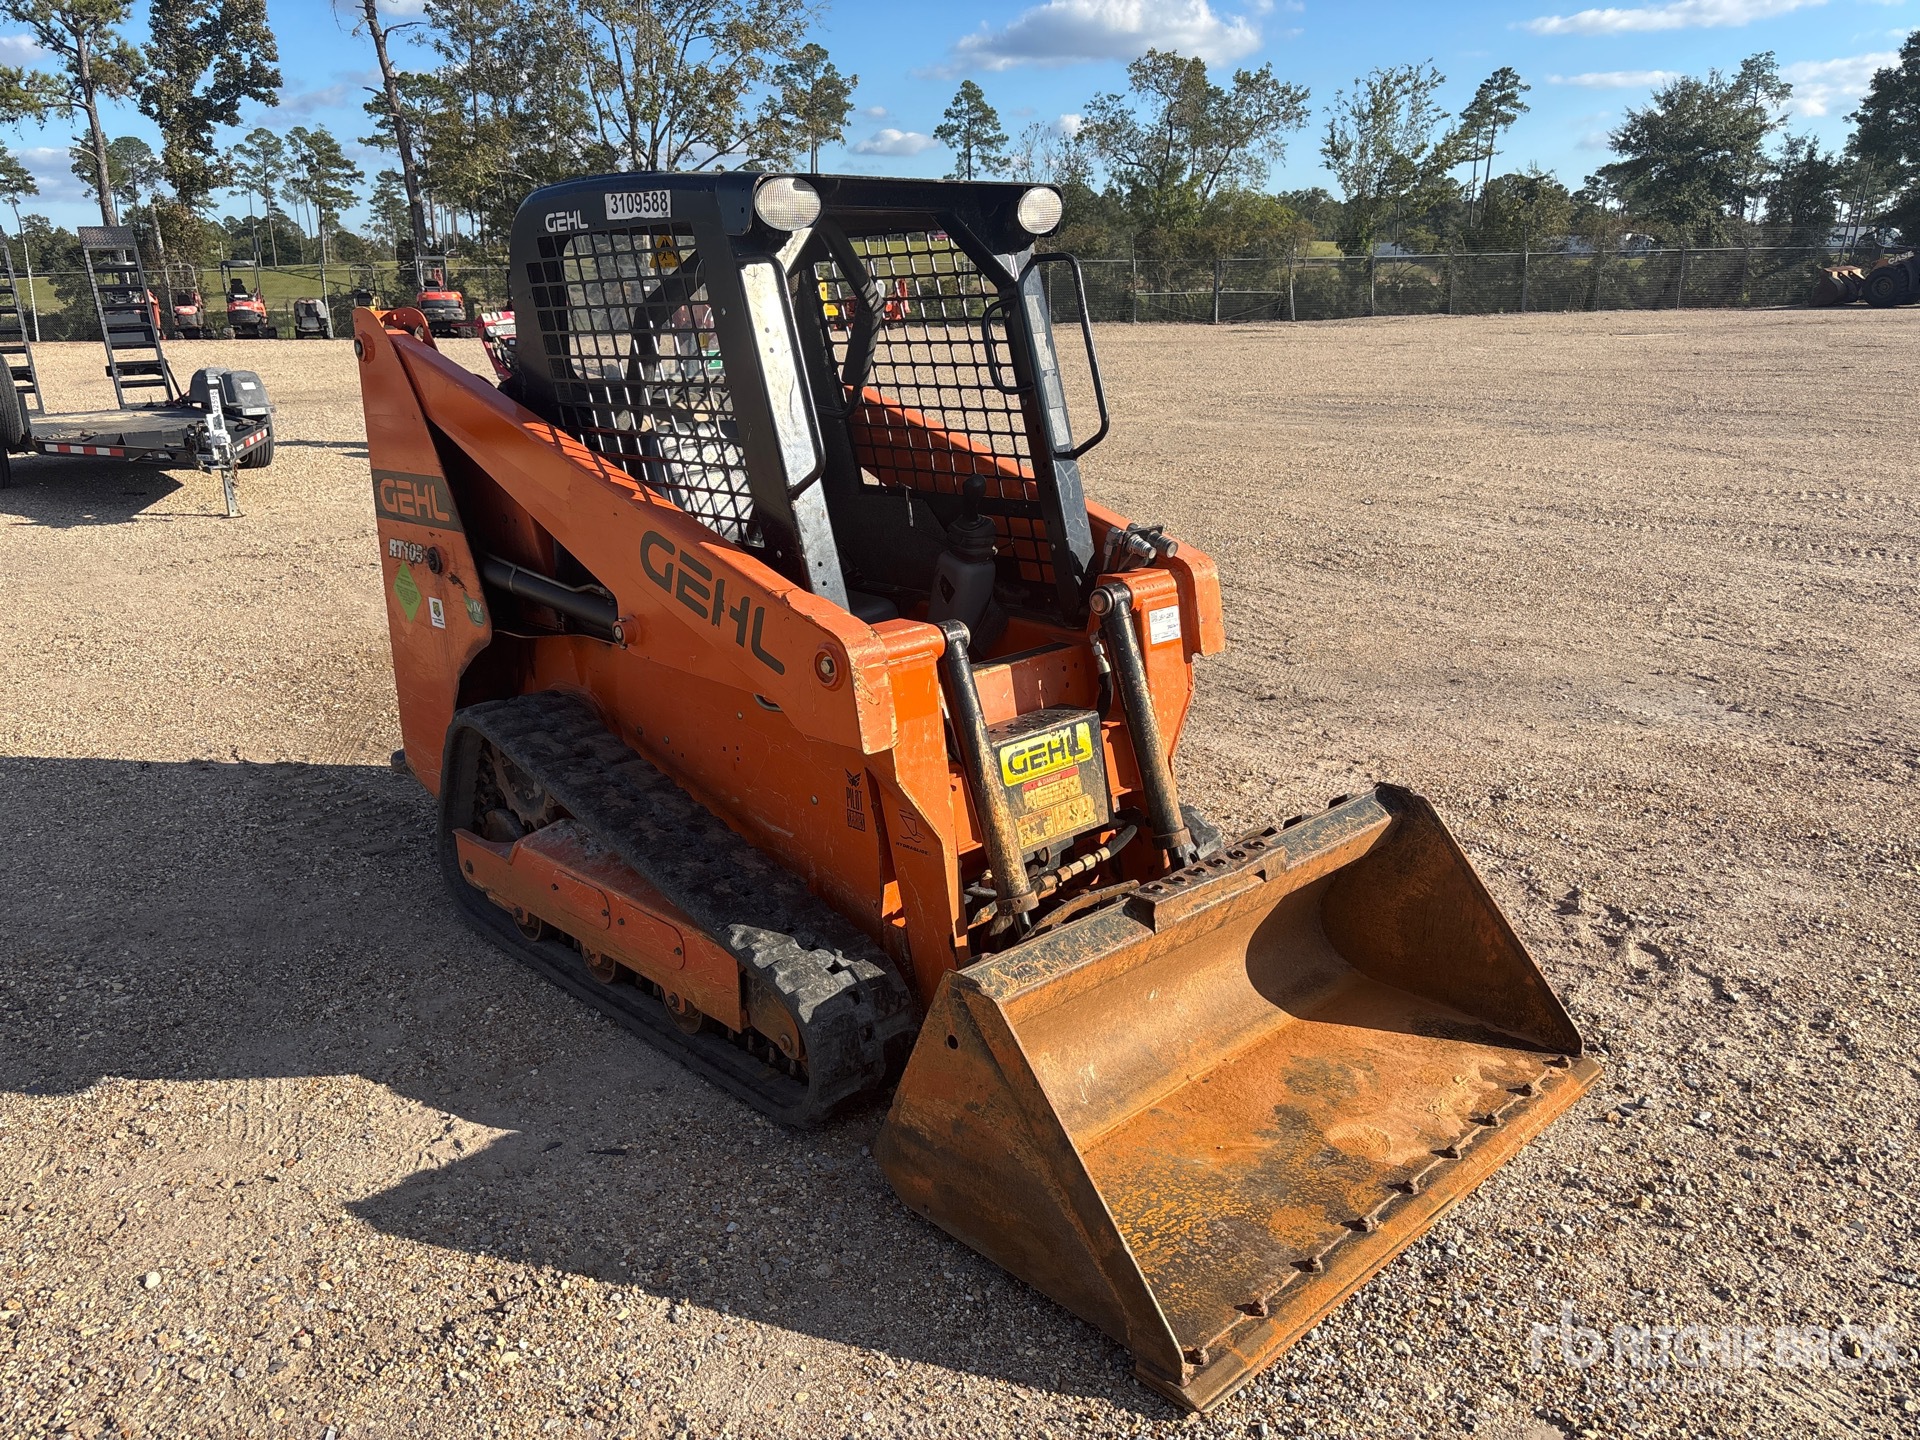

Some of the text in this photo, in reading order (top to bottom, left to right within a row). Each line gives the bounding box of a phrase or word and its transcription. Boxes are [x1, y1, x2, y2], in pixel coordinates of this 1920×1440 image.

[610, 191, 668, 215] 3109588
[545, 209, 589, 233] GEHL
[1888, 250, 1915, 265] CASE
[379, 478, 450, 522] GEHL
[640, 530, 786, 676] GEHL
[1008, 723, 1085, 776] GEHL
[845, 786, 863, 812] PILOT
